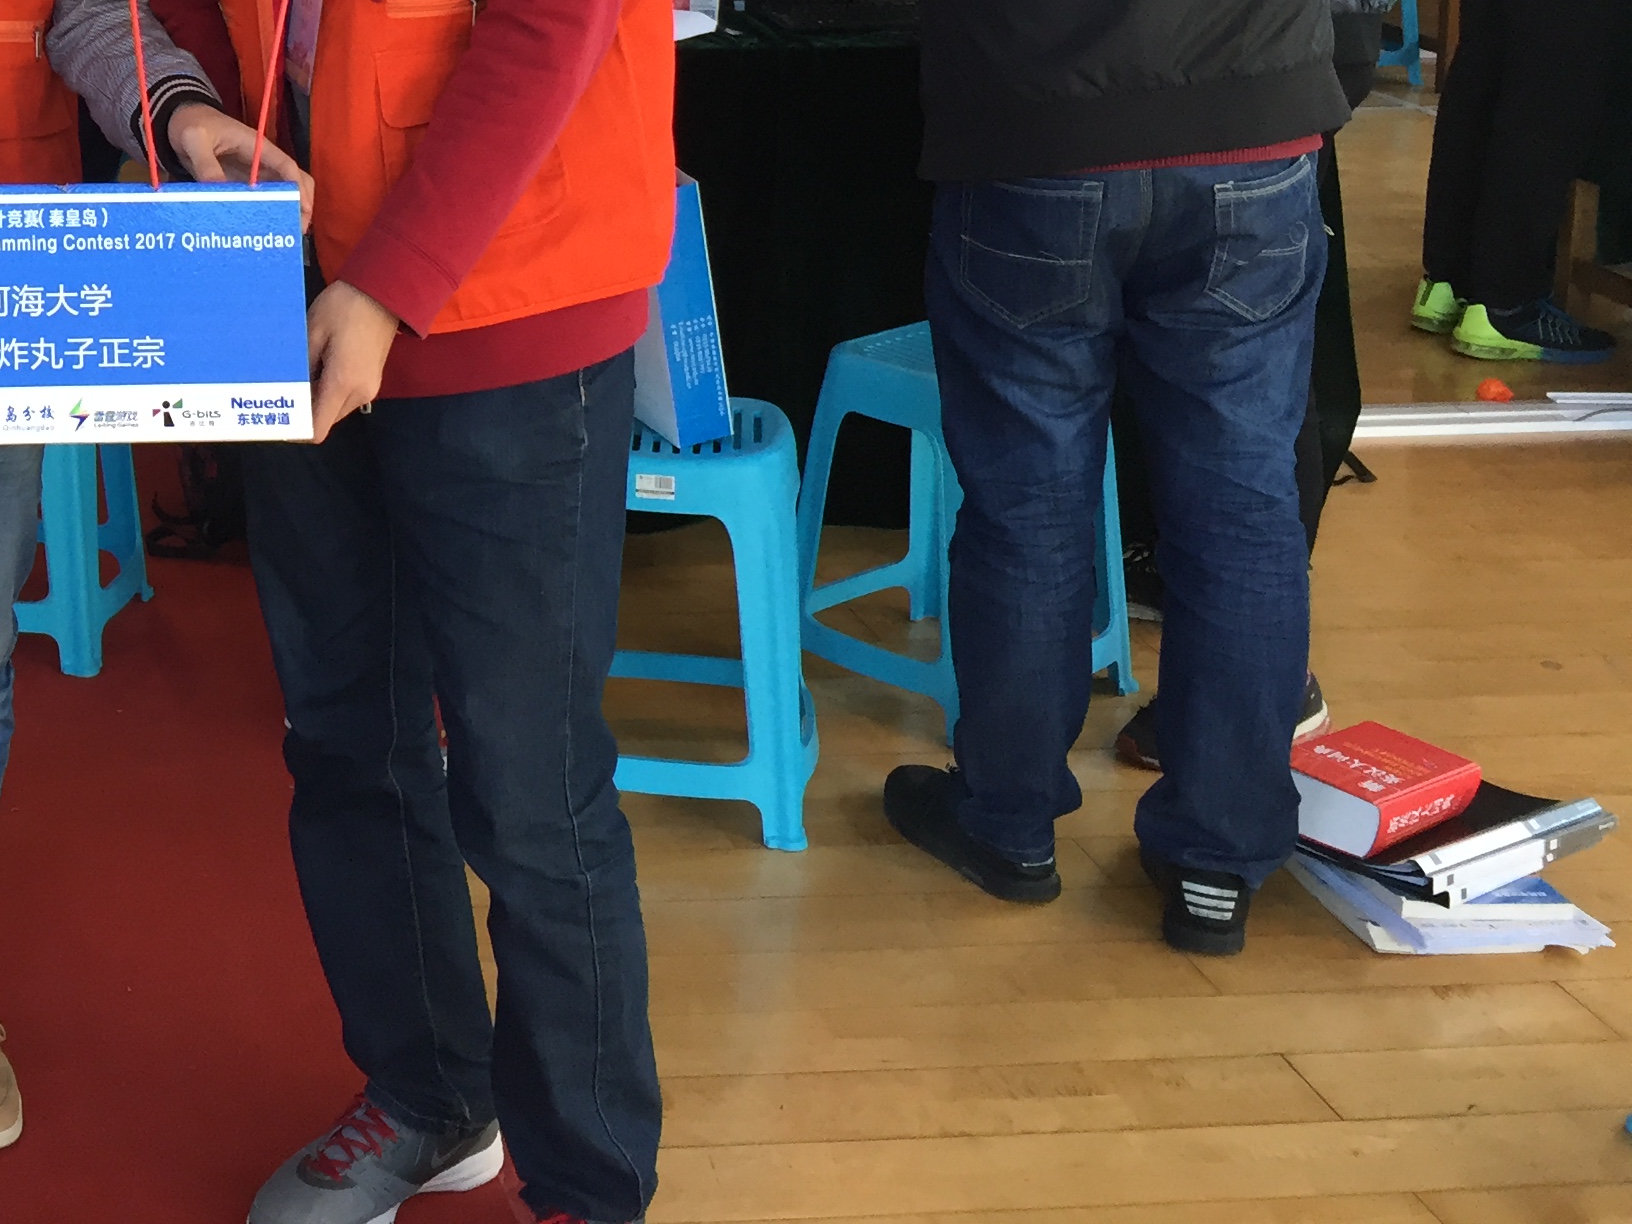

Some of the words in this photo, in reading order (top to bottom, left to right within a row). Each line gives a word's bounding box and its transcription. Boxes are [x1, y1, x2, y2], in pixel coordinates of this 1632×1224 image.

[63, 233, 130, 251] Contest
[135, 232, 175, 250] 2017
[181, 232, 295, 252] Qinhuangdao
[230, 396, 295, 409] Neuedu
[182, 410, 221, 419] G-bits
[237, 412, 291, 426] 东软睿道
